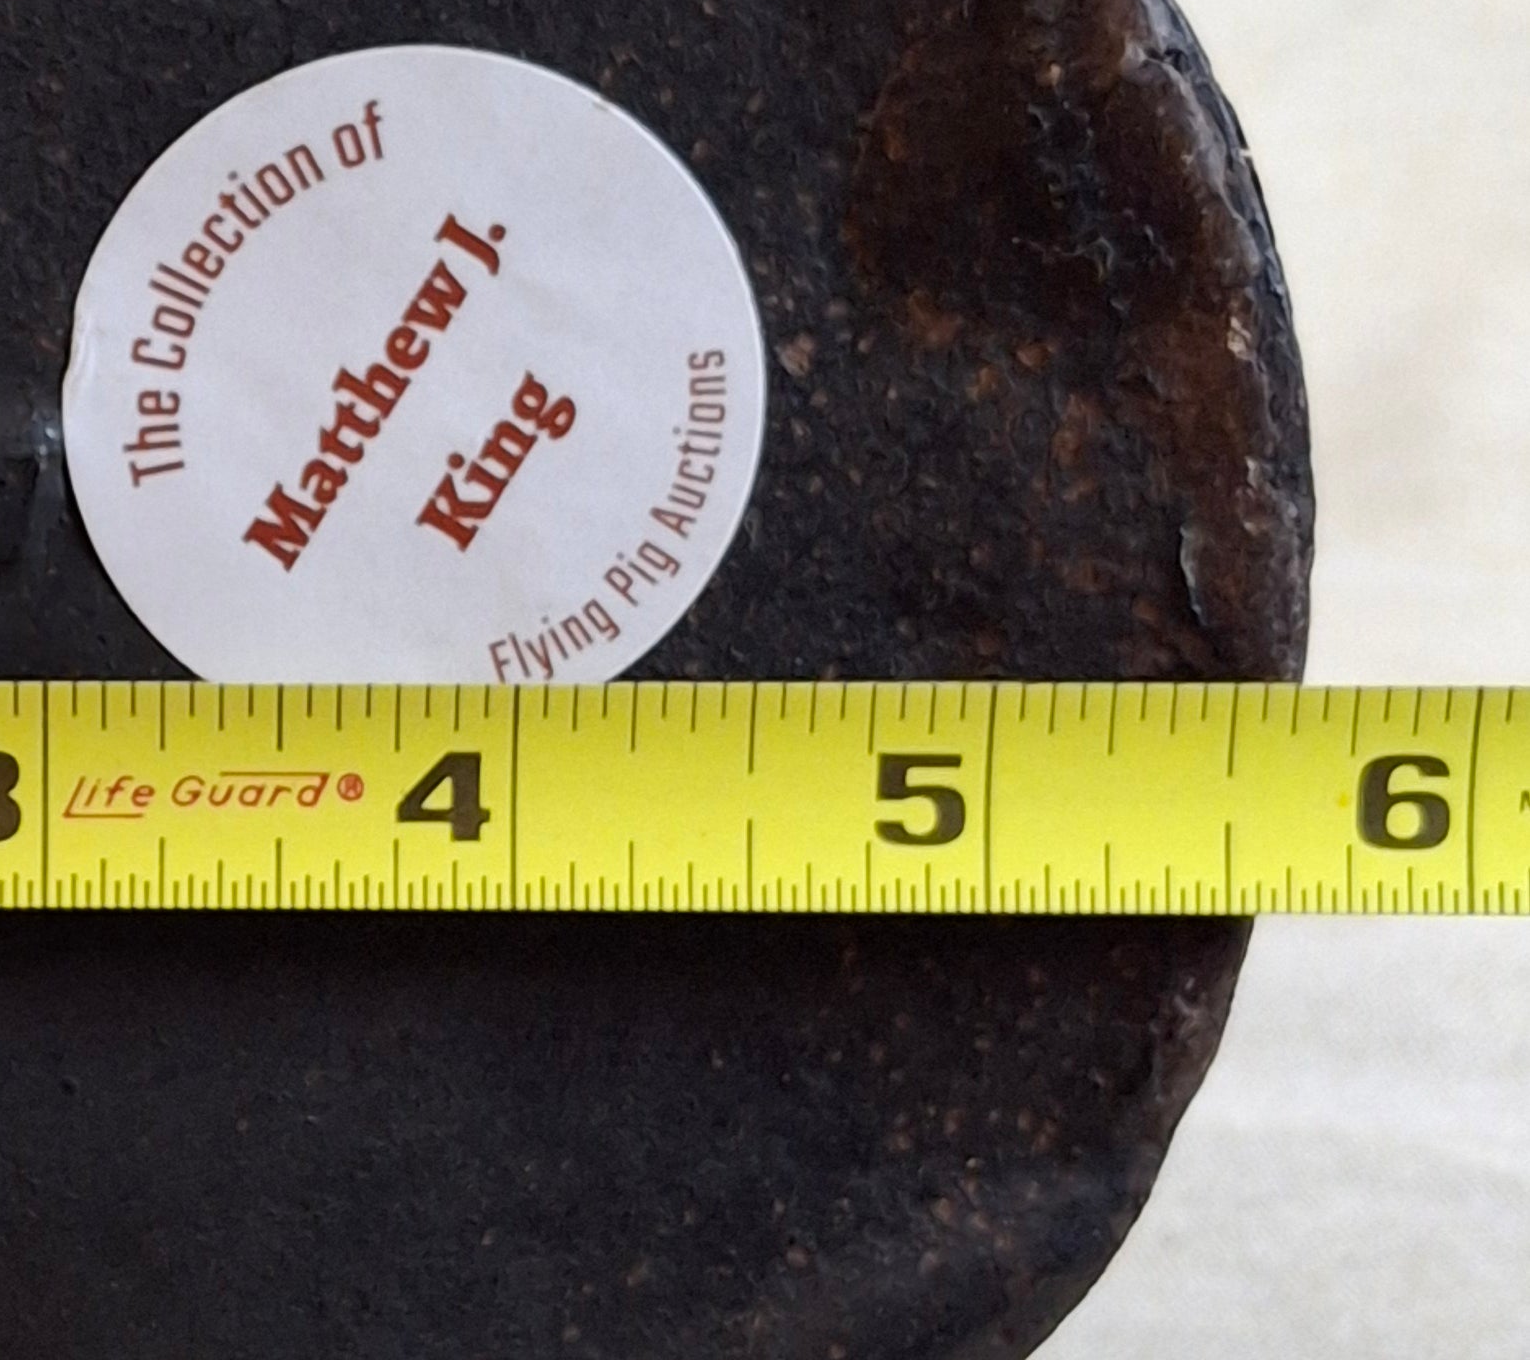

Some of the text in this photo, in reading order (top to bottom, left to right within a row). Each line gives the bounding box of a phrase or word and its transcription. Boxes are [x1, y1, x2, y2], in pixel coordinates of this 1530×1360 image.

[122, 99, 384, 488] The Collection of
[242, 214, 506, 572] Matthew J.
[417, 371, 577, 551] King
[488, 349, 725, 684] Flying Pig Auctions
[63, 775, 155, 818] Life
[397, 751, 491, 842] 4
[874, 753, 966, 846] 5
[1356, 755, 1451, 850] 6
